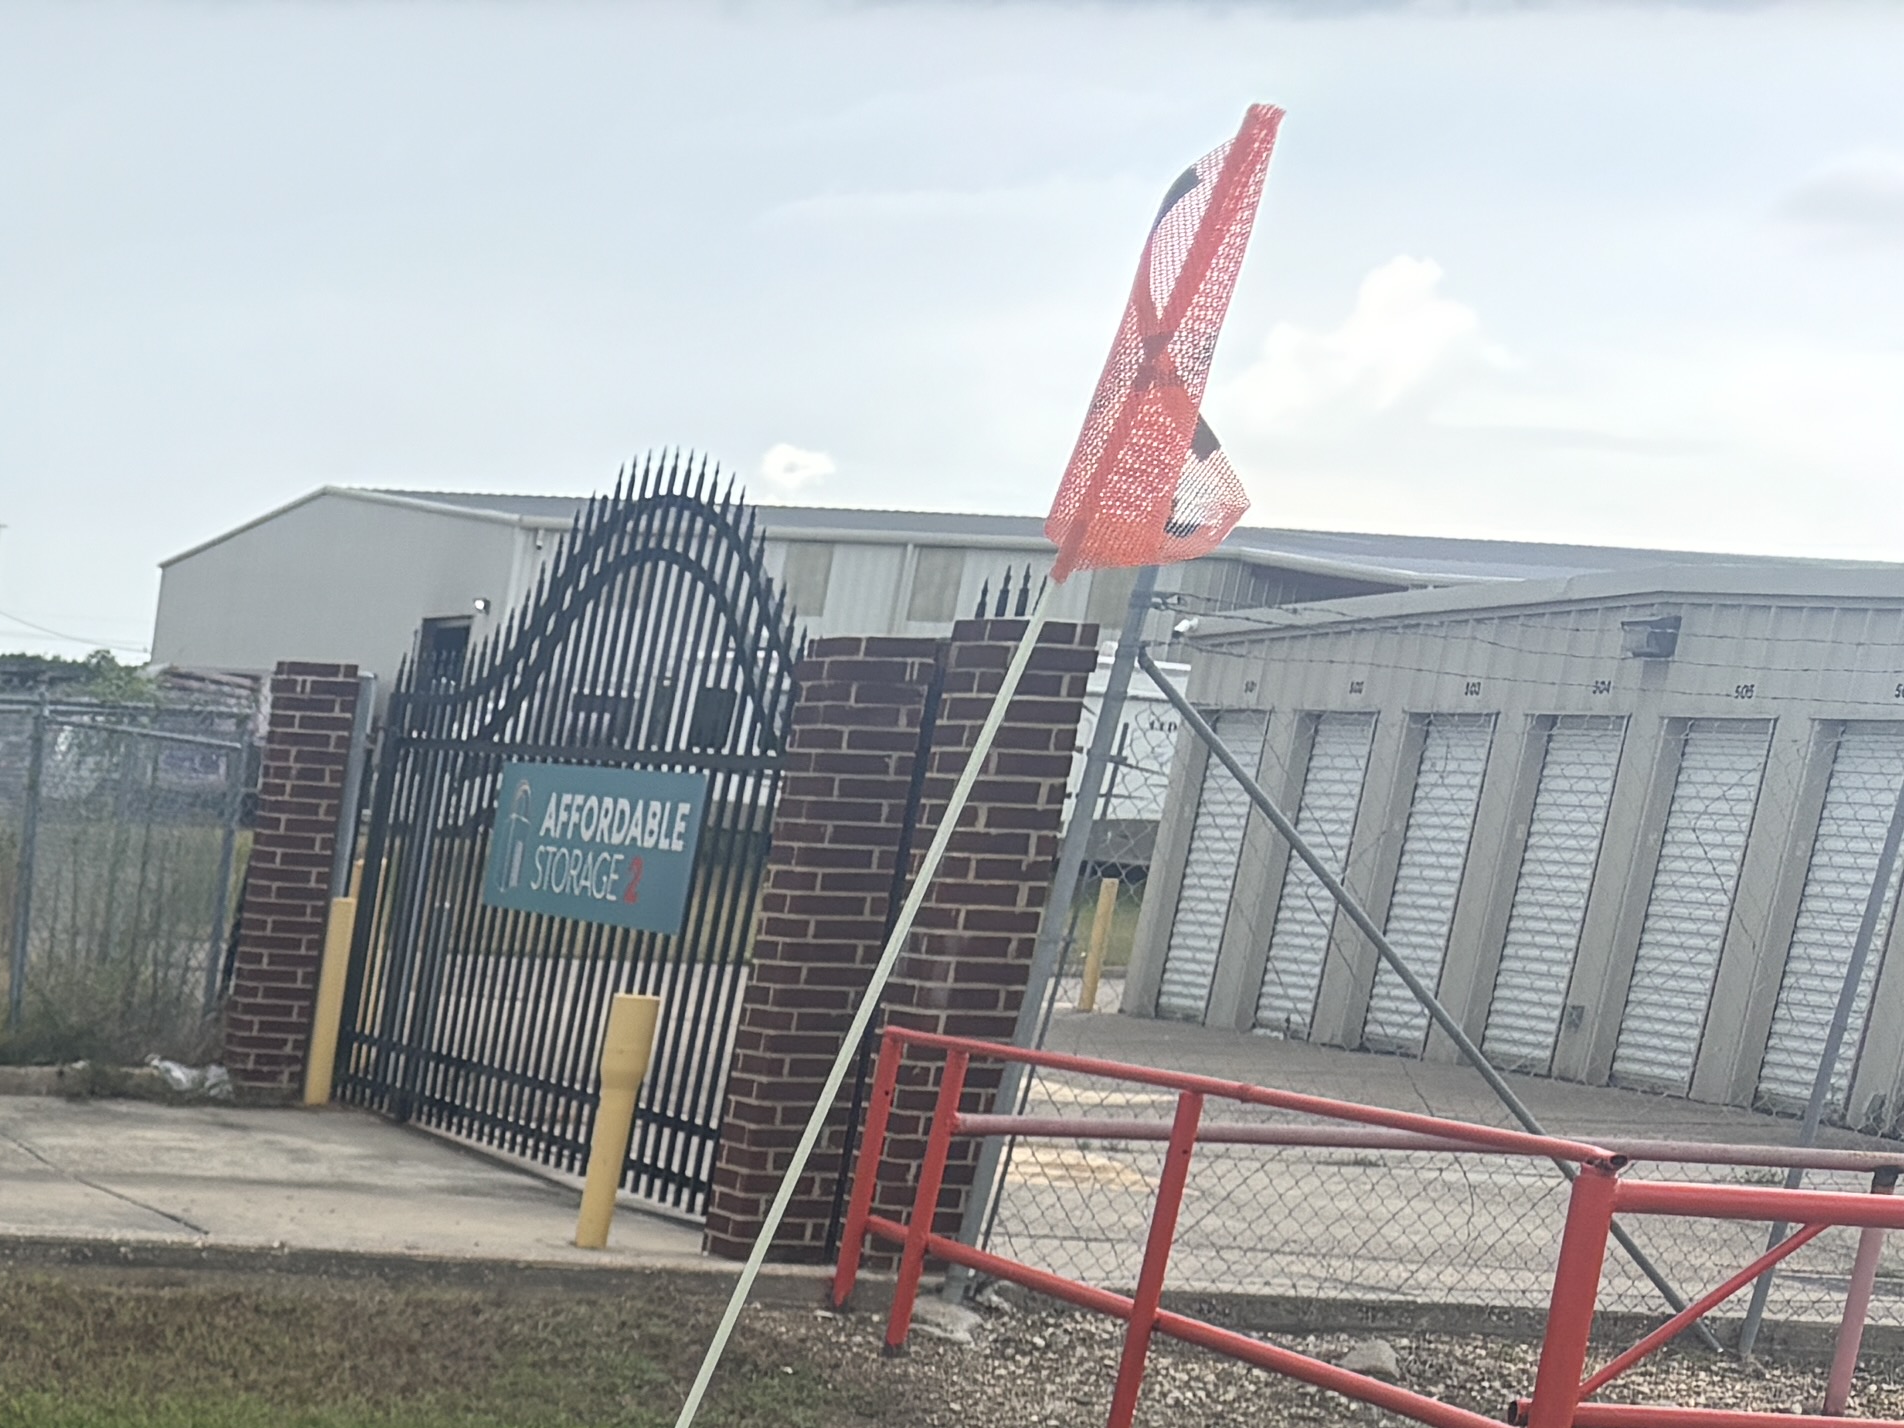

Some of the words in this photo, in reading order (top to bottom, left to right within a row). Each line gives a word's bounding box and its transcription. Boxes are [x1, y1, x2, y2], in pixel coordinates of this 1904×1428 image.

[539, 791, 691, 852] AFFORDABLE
[530, 845, 625, 901] STORAGE
[623, 854, 644, 905] 2
